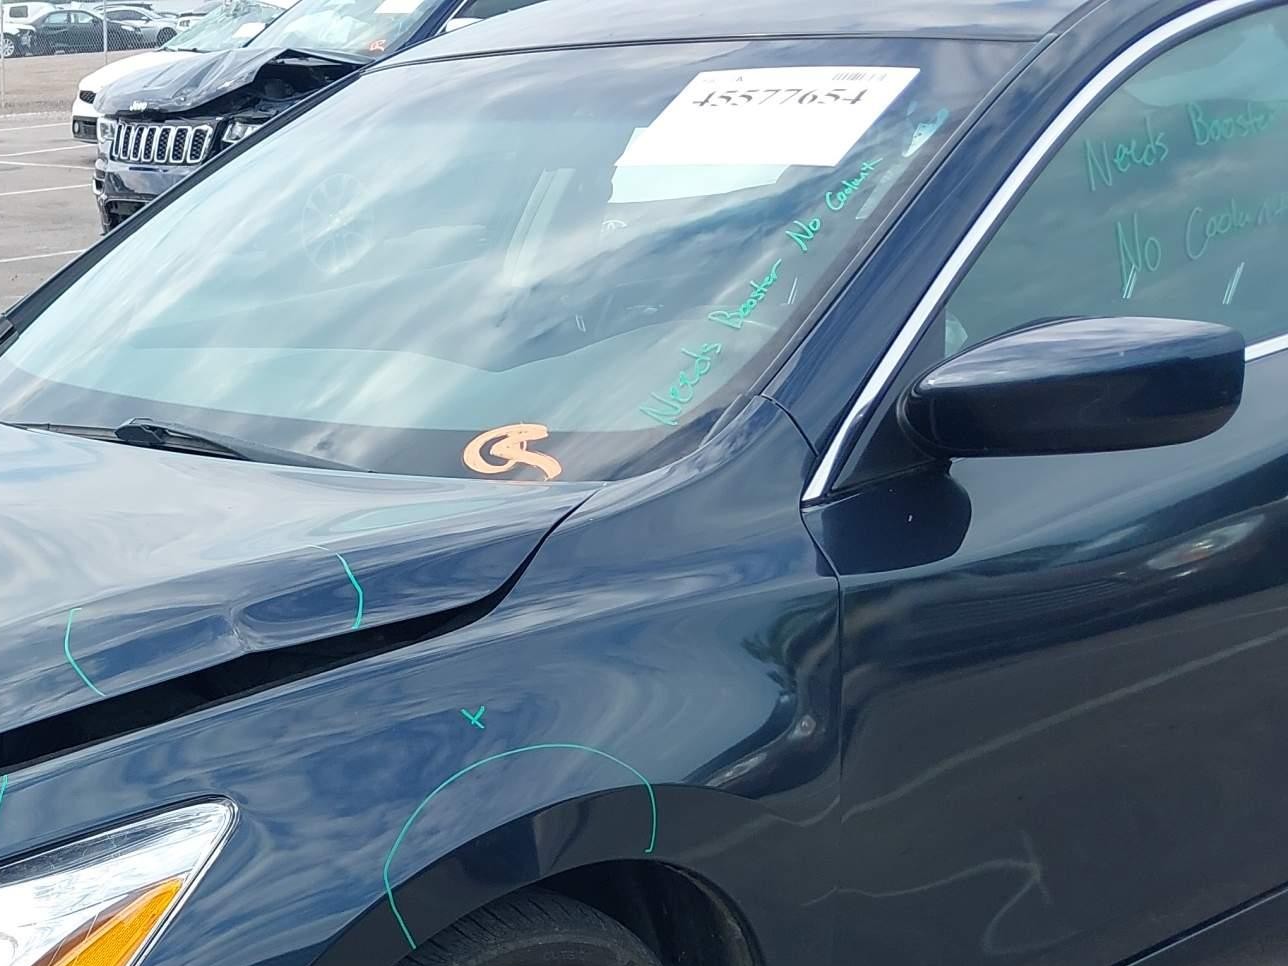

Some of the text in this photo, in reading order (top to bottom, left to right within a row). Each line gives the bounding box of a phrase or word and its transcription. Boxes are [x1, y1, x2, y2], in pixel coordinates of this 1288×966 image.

[1083, 115, 1169, 191] Needs
[1116, 211, 1161, 291] No
[639, 342, 722, 426] Needs
[708, 258, 782, 329] Booster
[785, 217, 821, 252] No
